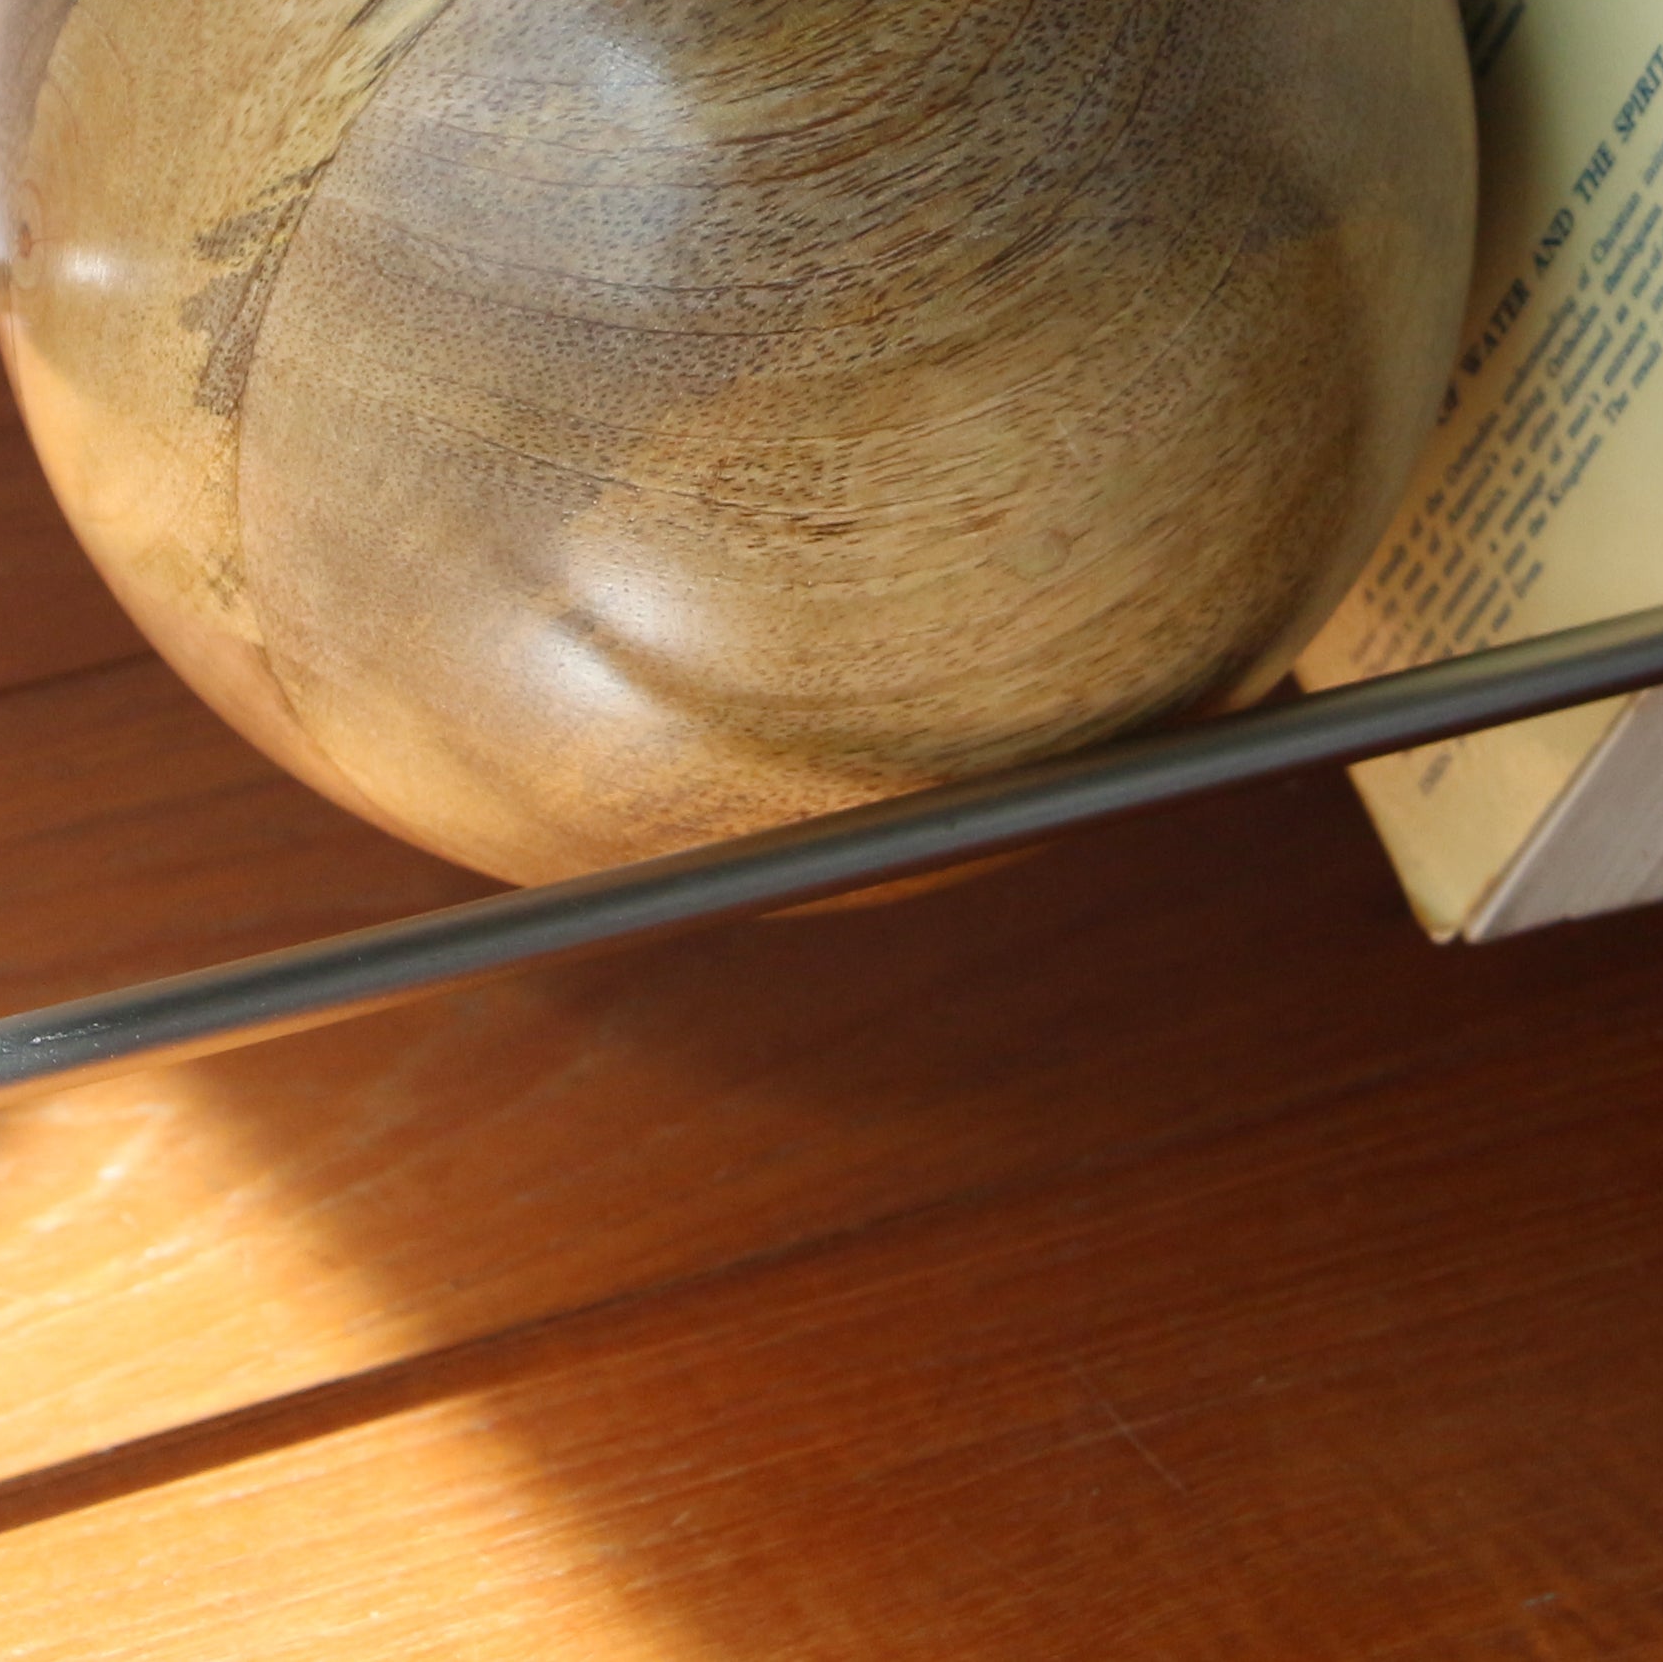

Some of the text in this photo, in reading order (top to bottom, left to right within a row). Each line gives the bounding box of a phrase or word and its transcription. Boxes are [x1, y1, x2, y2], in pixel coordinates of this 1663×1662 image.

[1529, 203, 1575, 277] AND
[1571, 140, 1614, 205] THE
[1589, 188, 1642, 267] Christian
